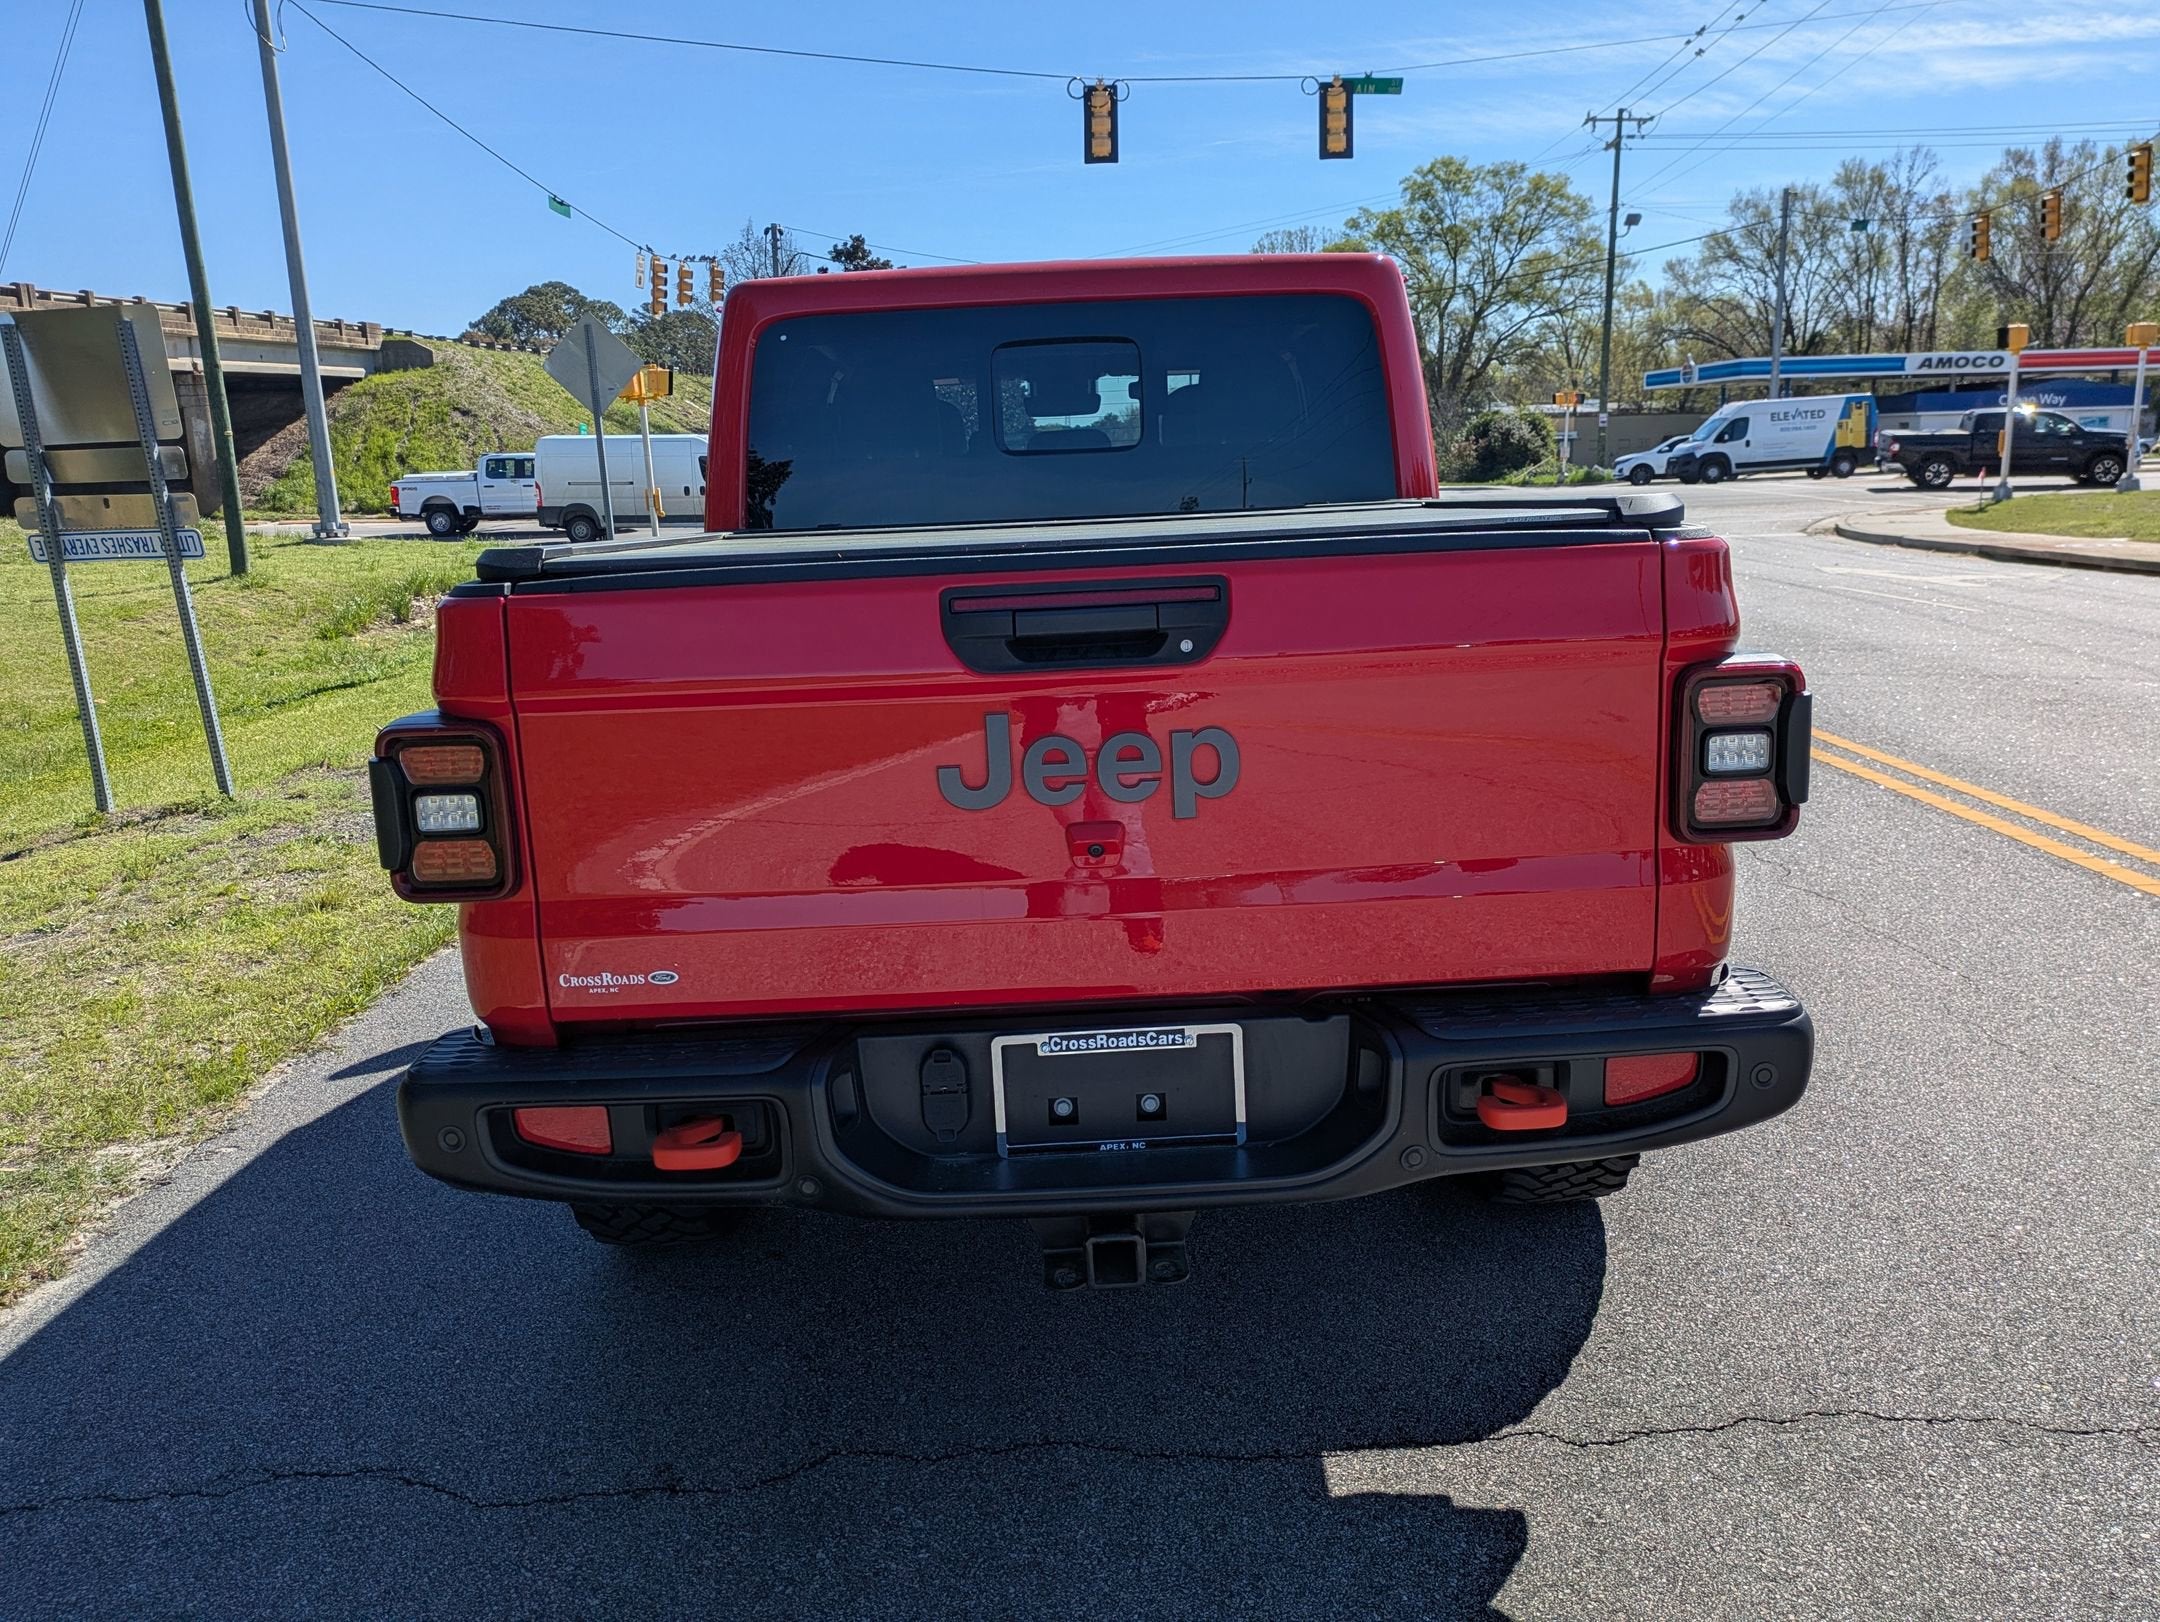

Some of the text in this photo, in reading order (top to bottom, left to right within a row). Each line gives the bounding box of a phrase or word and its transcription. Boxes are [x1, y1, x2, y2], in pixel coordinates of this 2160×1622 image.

[1356, 84, 1376, 94] AIN
[1918, 355, 2005, 370] AMOCO
[2039, 392, 2068, 407] Way
[1770, 408, 1826, 422] ELEVATED
[34, 535, 199, 557] LITR TRASHES EVERYE
[936, 711, 1241, 820] Jeep
[1050, 1032, 1183, 1051] CrossRoadsCars
[1099, 1143, 1129, 1151] APEX,
